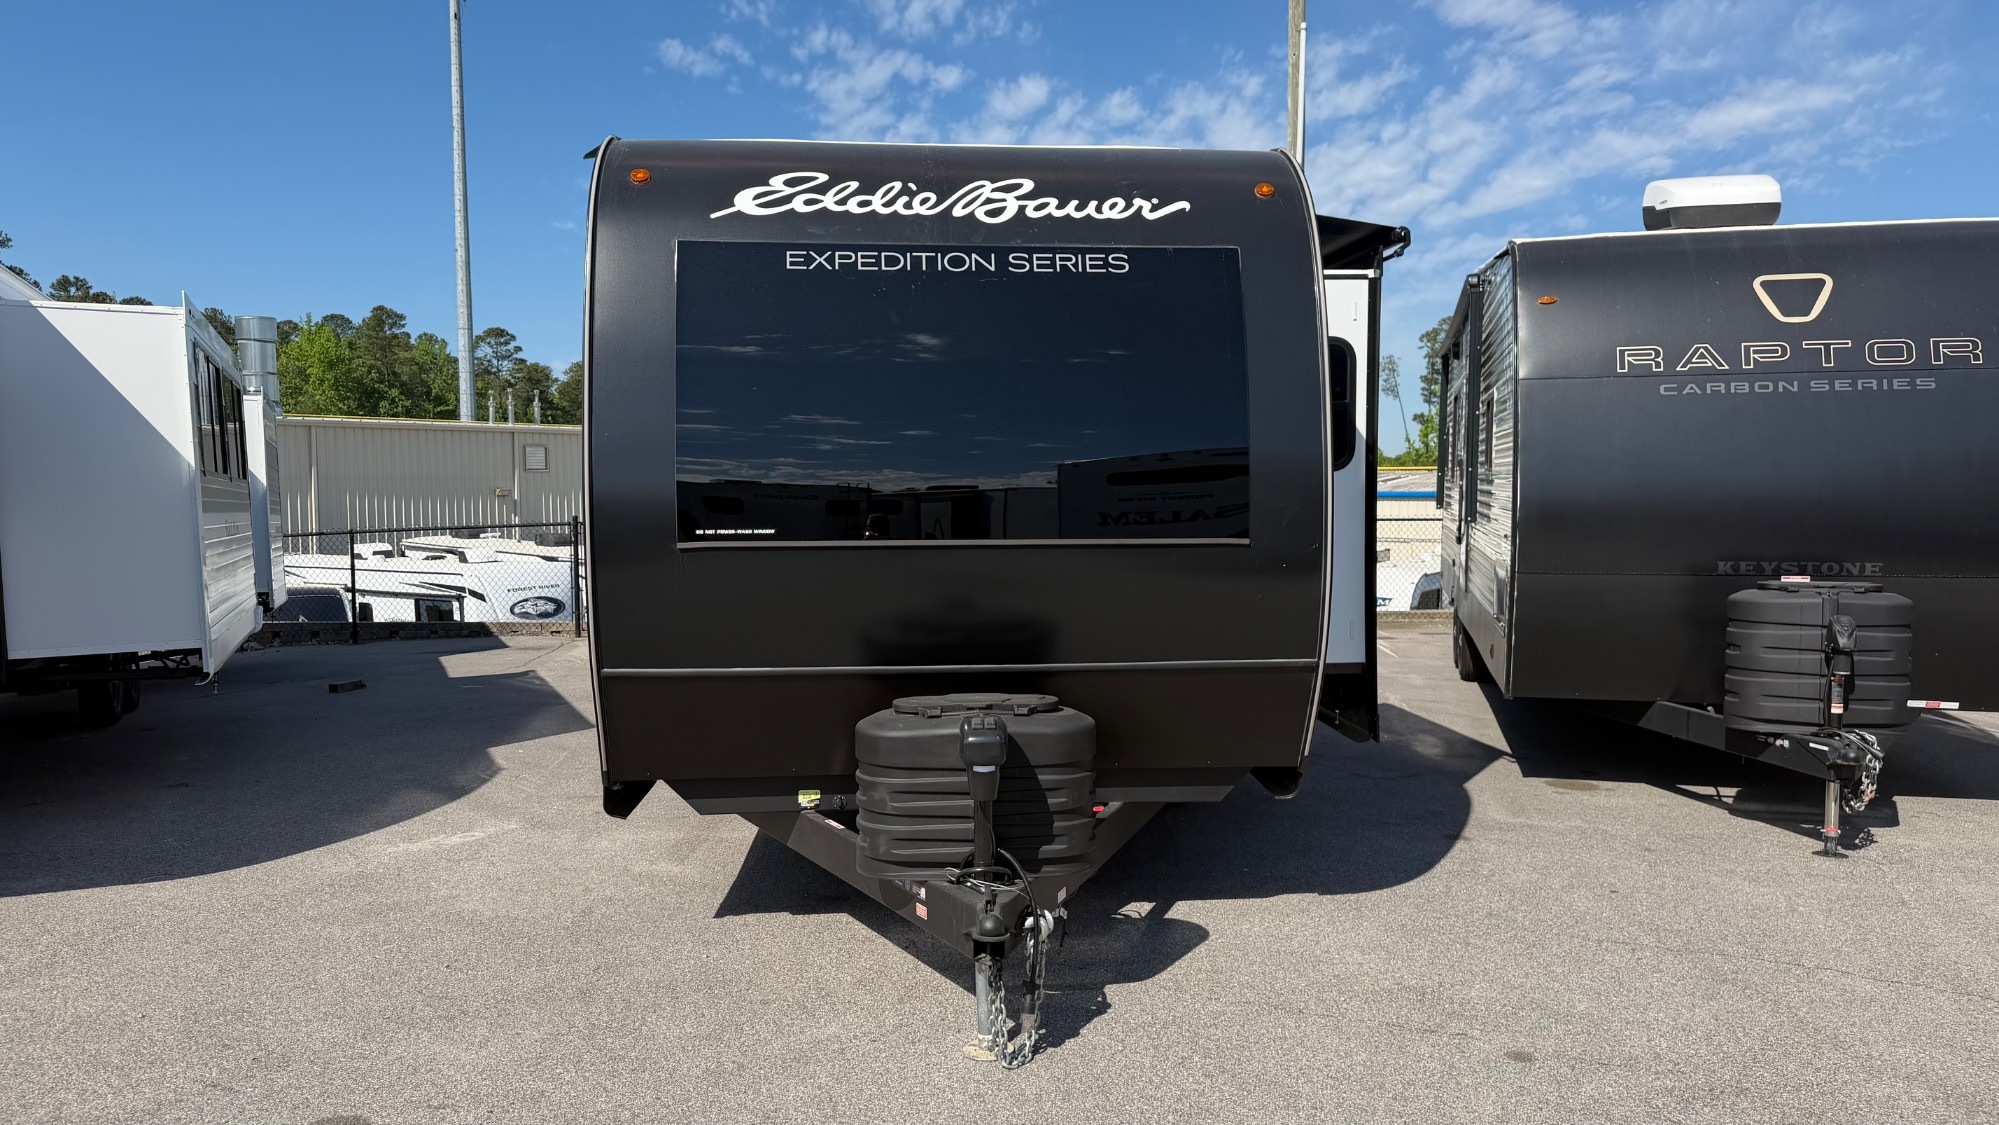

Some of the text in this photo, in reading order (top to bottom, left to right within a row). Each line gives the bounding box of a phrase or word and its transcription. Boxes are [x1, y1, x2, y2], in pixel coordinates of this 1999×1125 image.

[709, 171, 943, 219] Eddie
[786, 250, 1130, 274] EXPEDITION SERIES
[1616, 337, 1984, 373] RAPTOR
[1659, 377, 1938, 396] CARBON SERIES
[1716, 560, 1884, 577] KEYSTONE
[507, 585, 537, 593] FOREST
